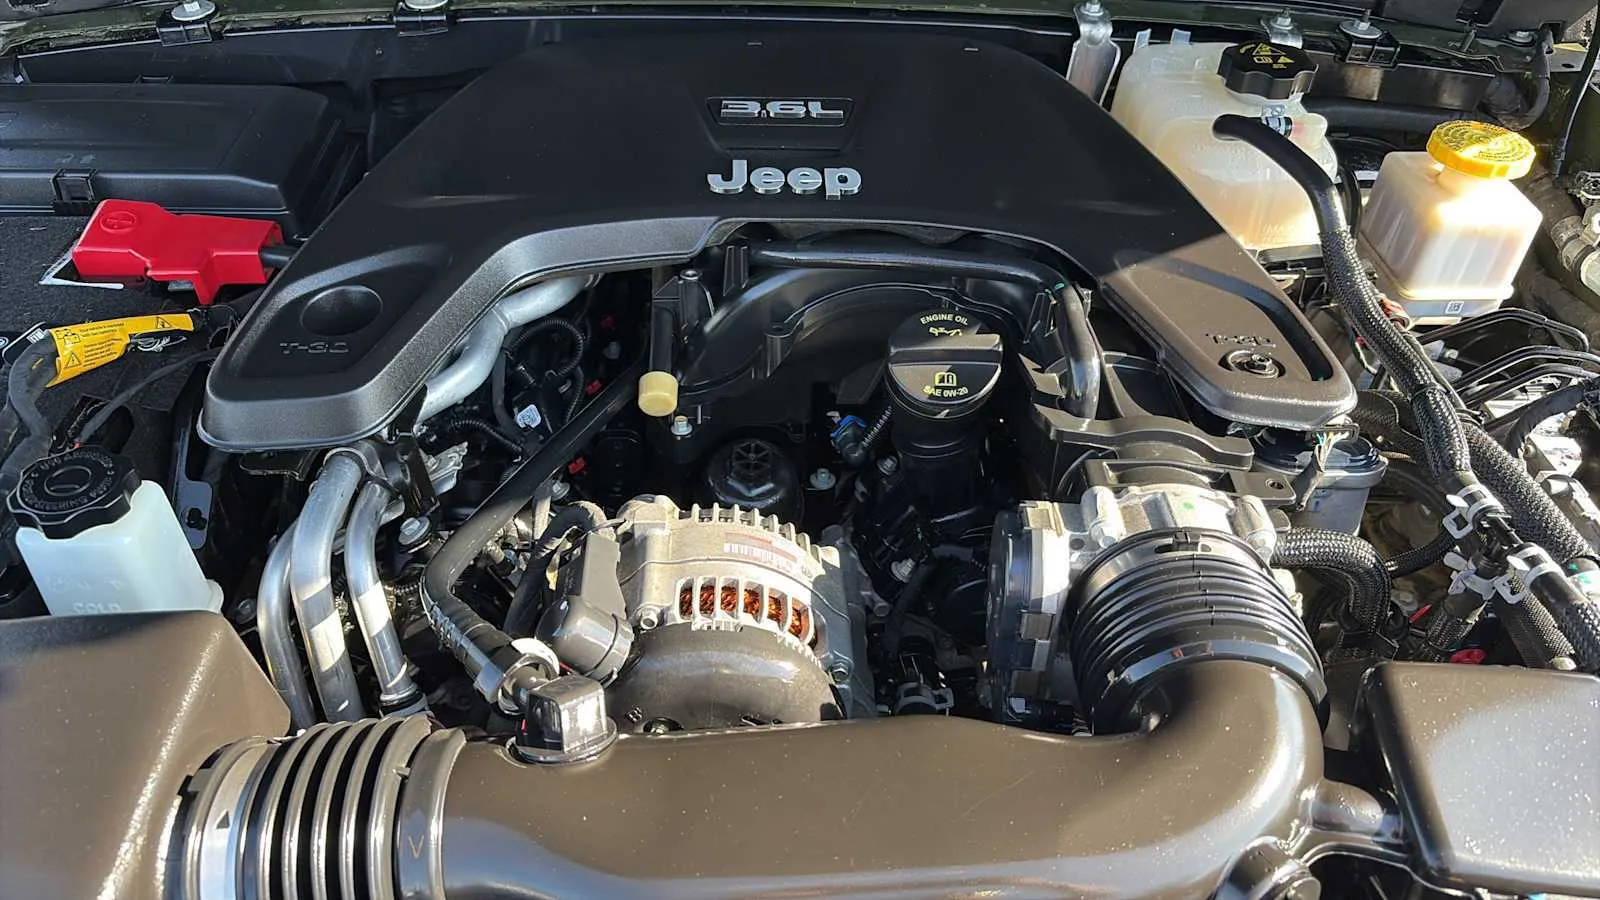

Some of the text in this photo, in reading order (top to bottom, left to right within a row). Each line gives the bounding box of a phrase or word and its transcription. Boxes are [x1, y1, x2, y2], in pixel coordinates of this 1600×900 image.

[720, 100, 844, 118] 3.6L
[707, 159, 862, 200] Jeep
[920, 314, 969, 325] ENGINE OIL
[923, 385, 969, 398] SAE 0W-20
